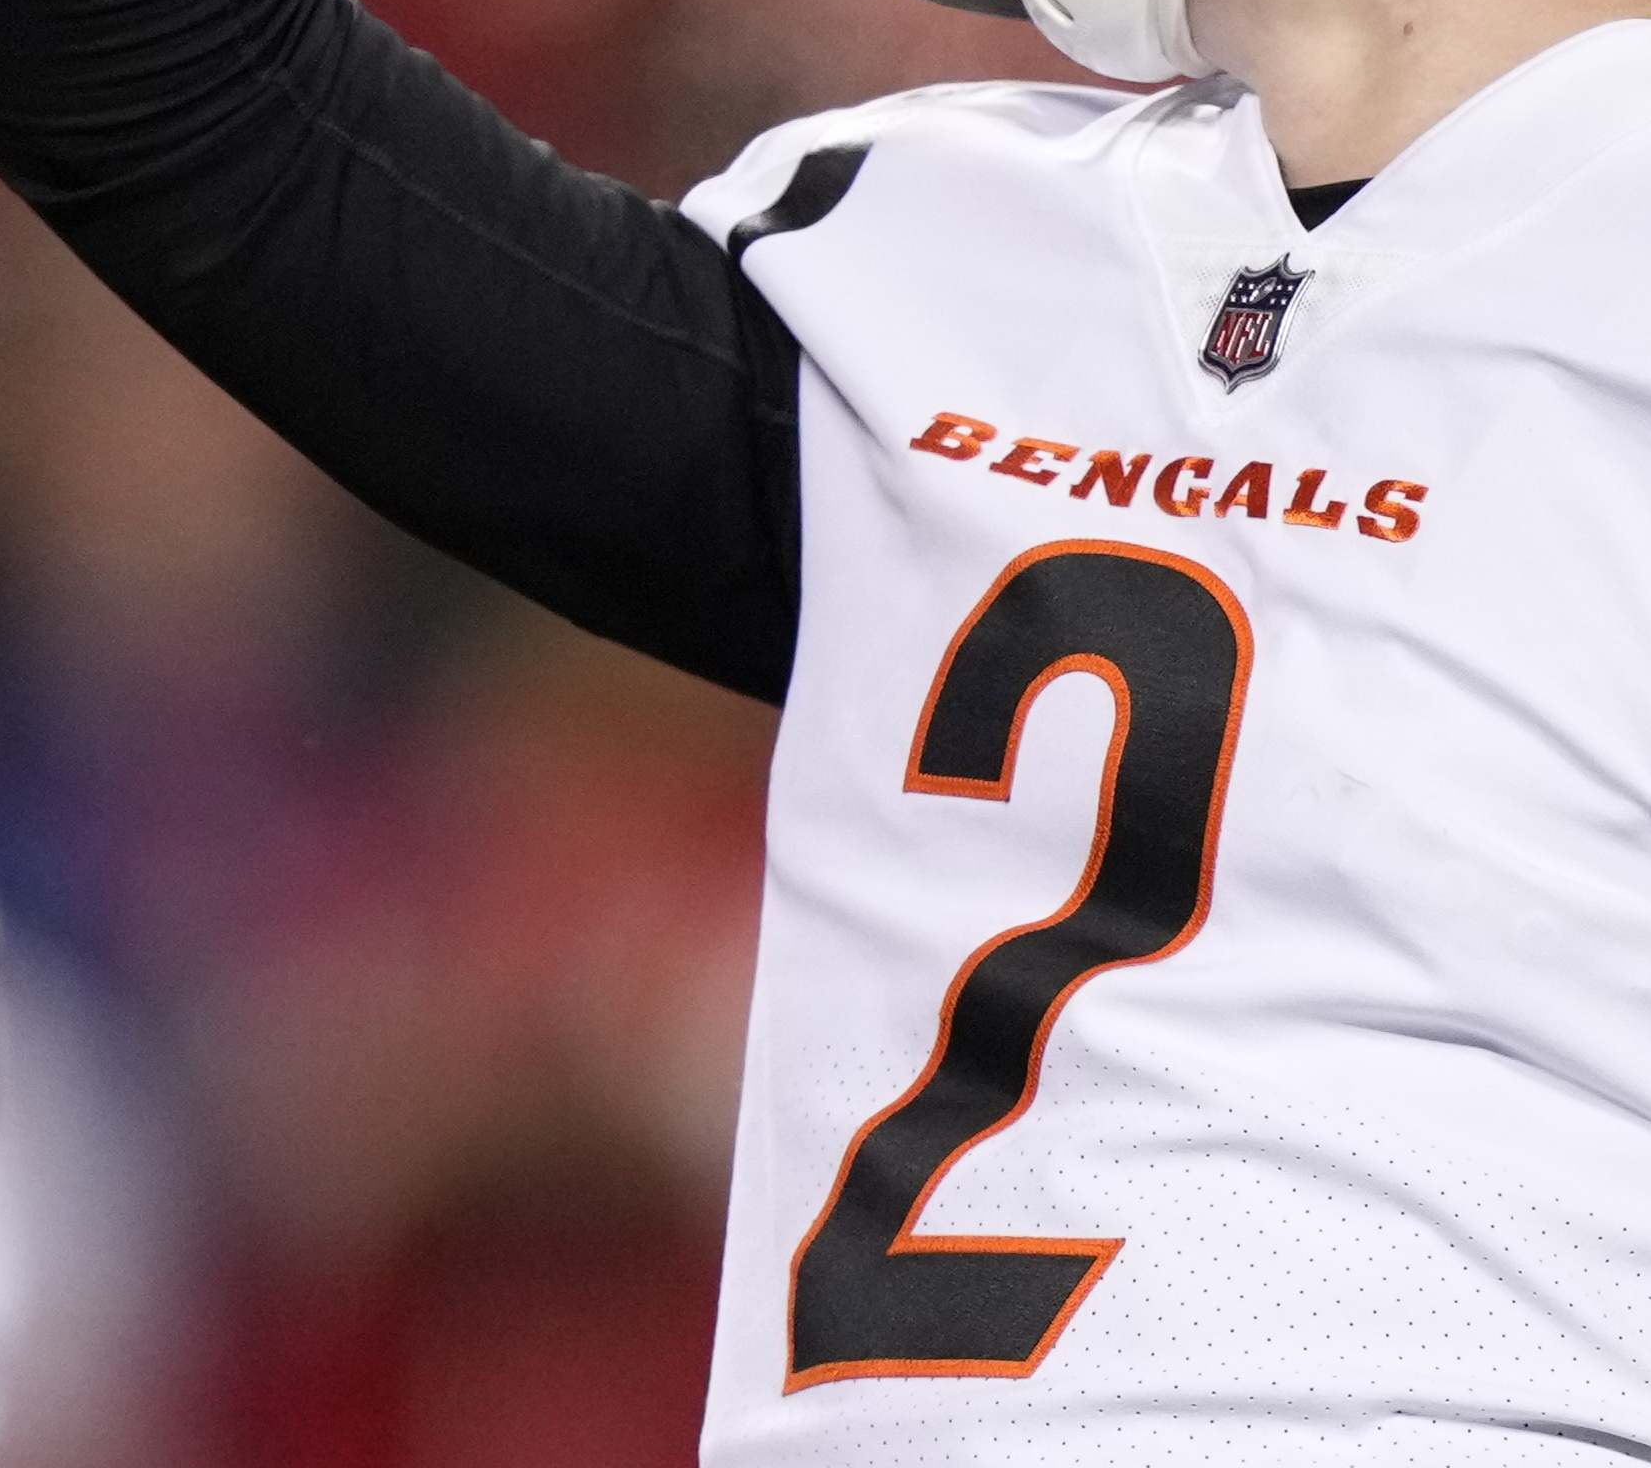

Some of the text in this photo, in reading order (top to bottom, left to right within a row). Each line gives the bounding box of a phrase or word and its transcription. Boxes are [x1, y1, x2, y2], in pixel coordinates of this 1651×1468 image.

[1209, 310, 1273, 364] NFL
[909, 410, 1430, 543] BENGALS
[782, 537, 1255, 1396] 2
